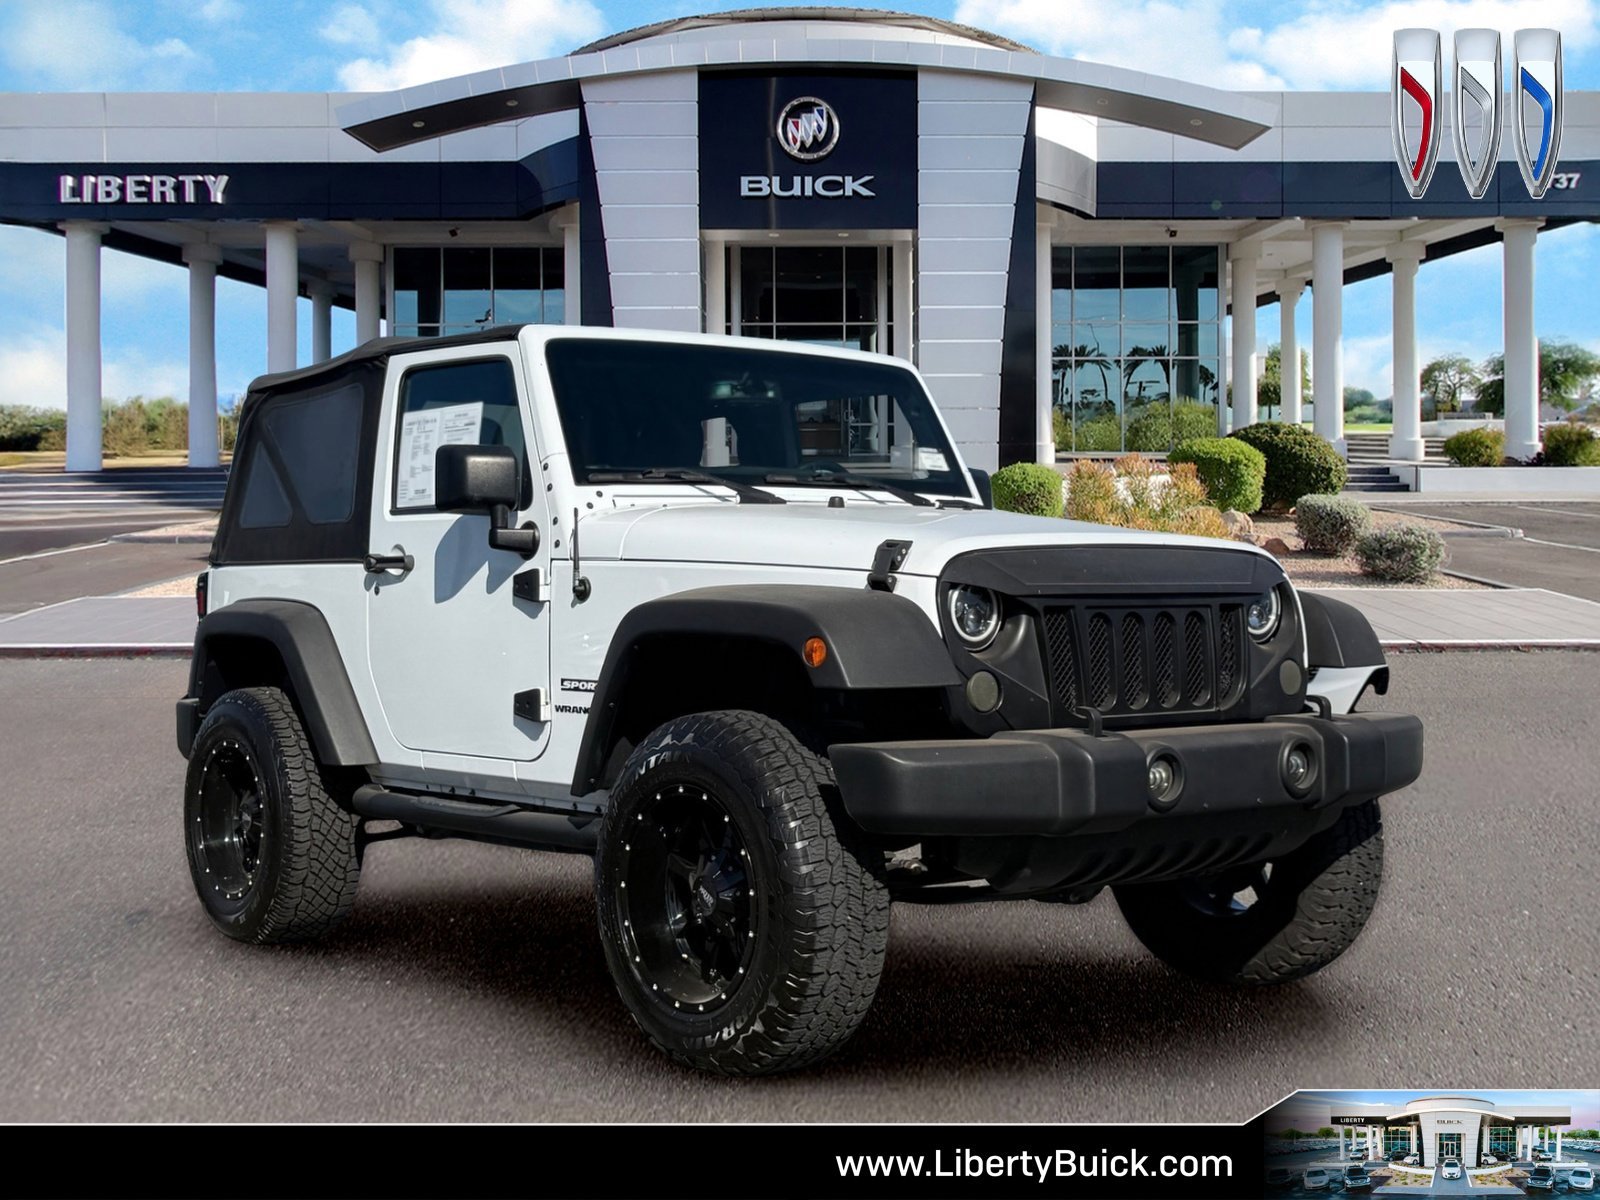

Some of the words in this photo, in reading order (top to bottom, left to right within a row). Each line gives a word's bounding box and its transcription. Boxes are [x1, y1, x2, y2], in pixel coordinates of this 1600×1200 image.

[59, 175, 229, 204] LIBERTY
[740, 175, 876, 197] BUICK
[560, 679, 598, 691] SPOR
